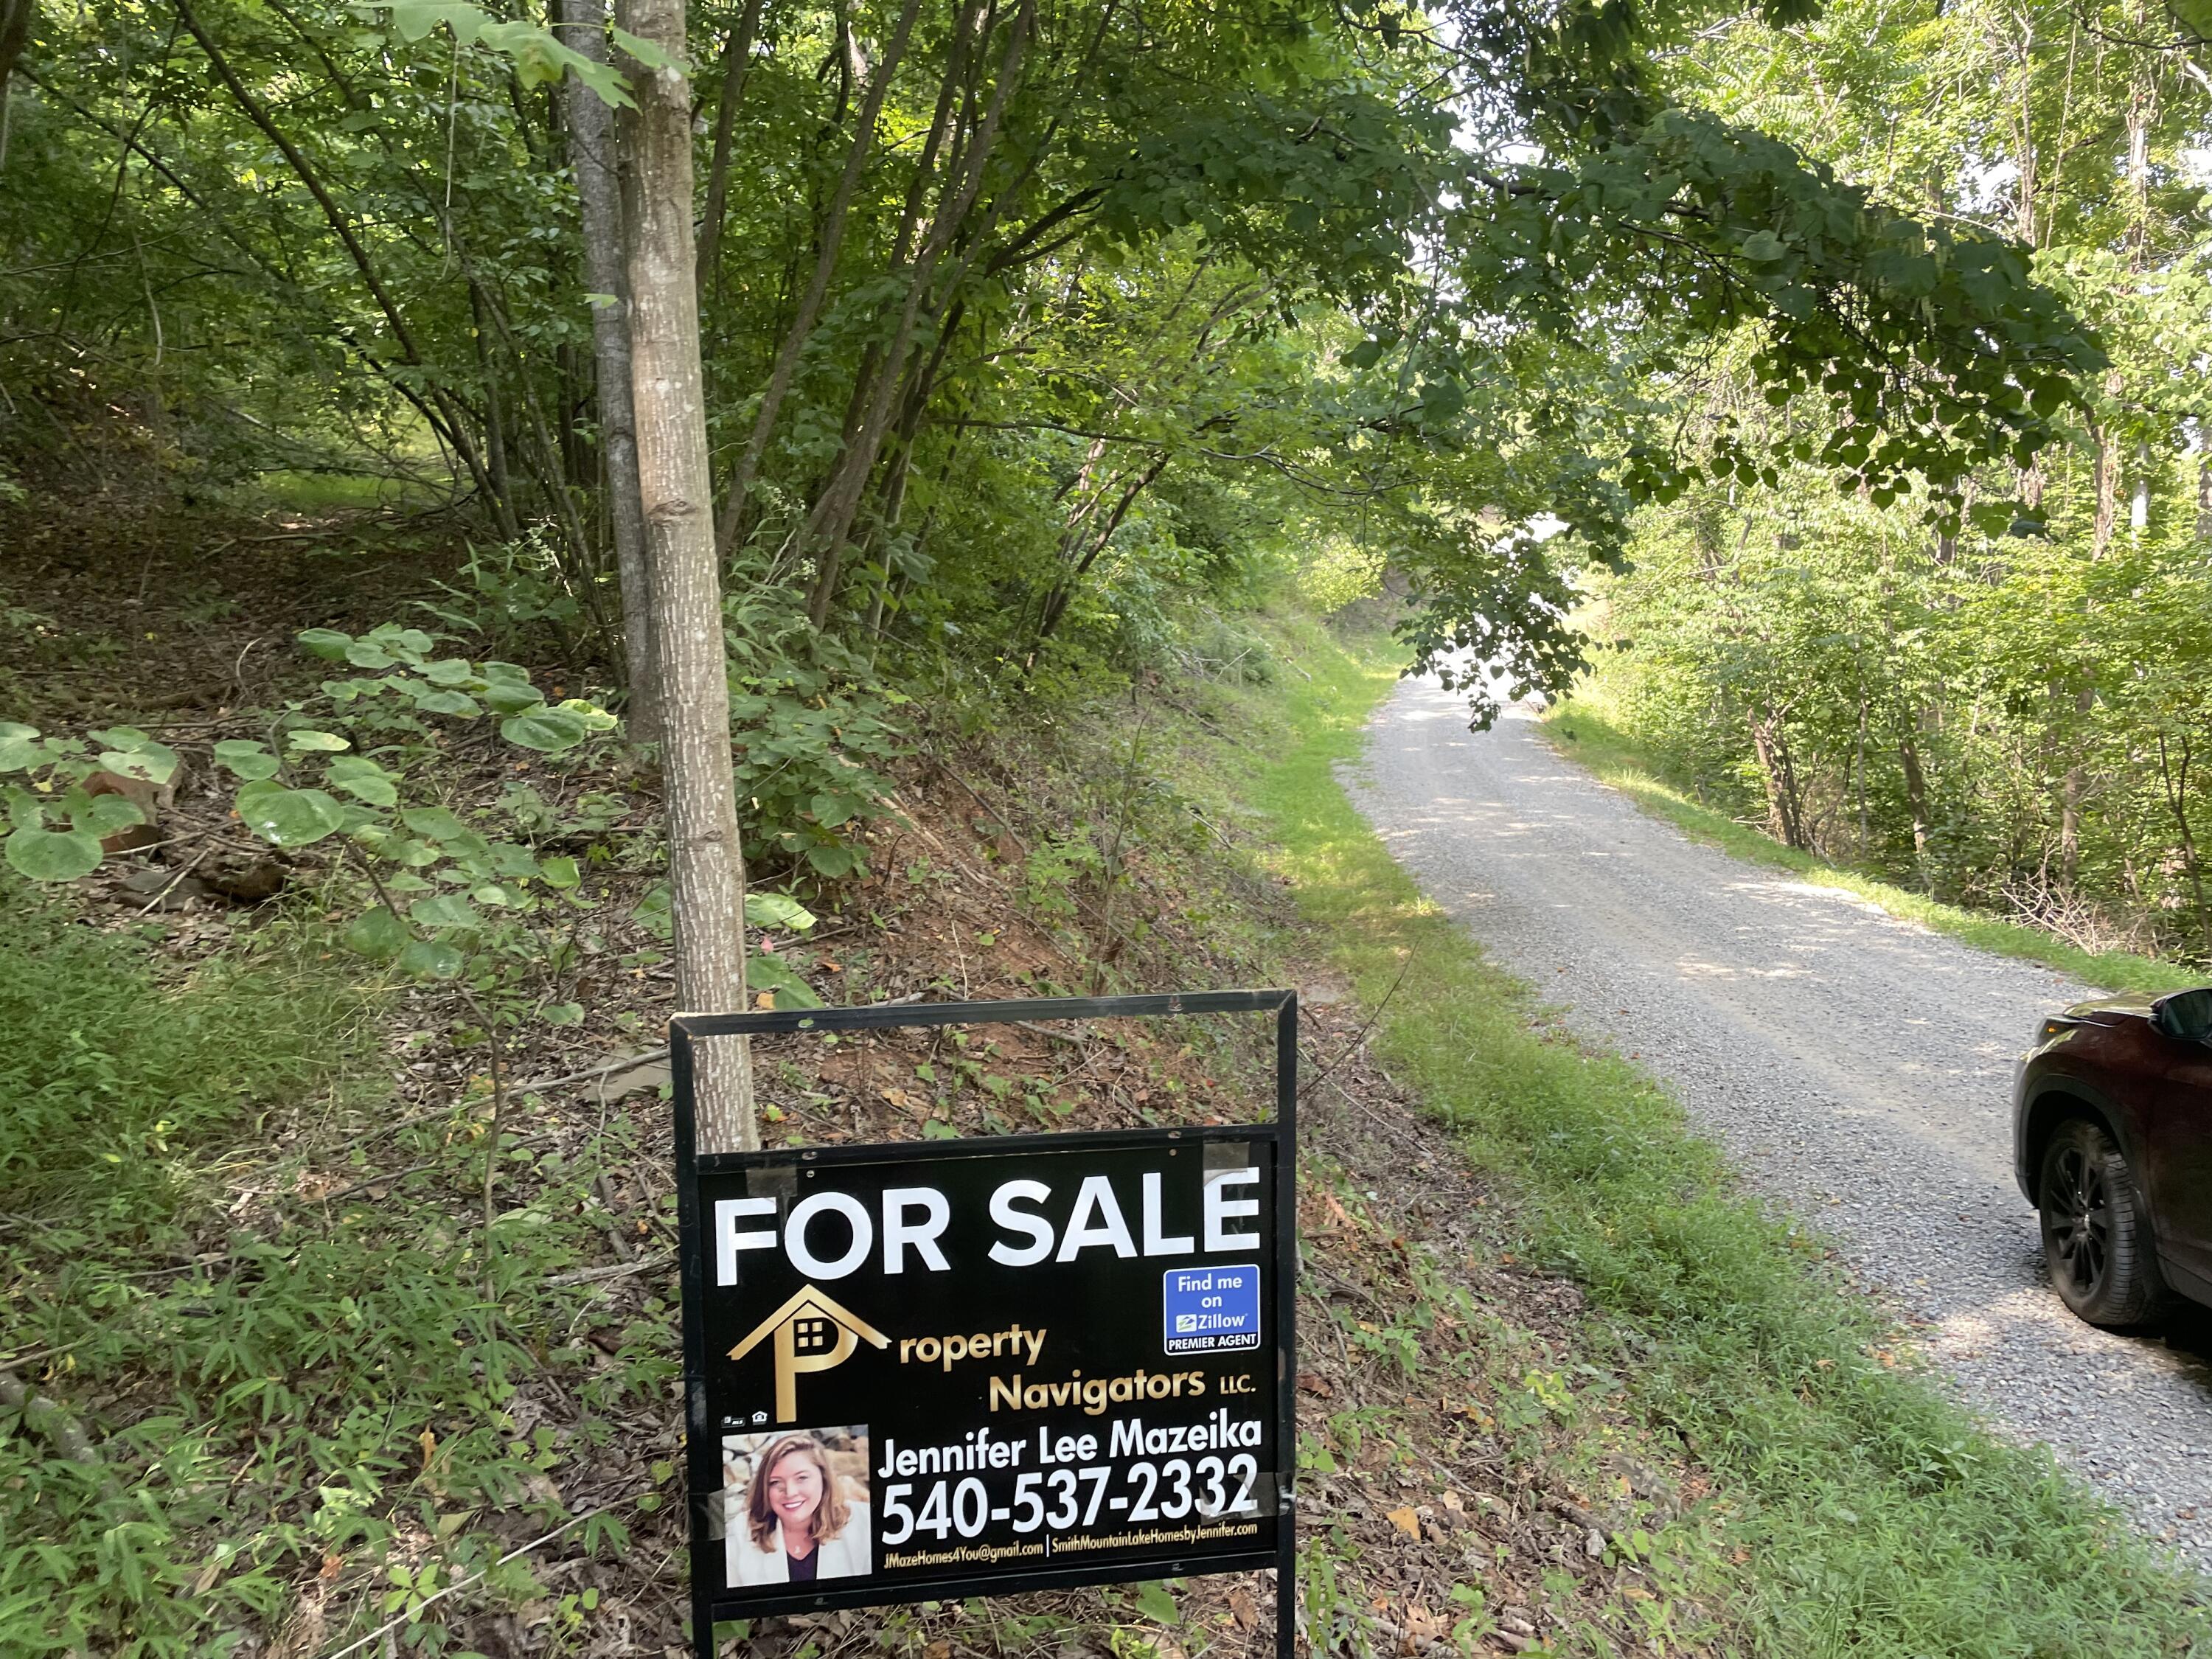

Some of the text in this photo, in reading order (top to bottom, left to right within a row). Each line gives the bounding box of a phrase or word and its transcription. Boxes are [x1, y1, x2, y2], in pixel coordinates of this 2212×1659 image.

[714, 1167, 1260, 1286] FOR SALE
[1178, 1273, 1243, 1292] Find me
[1201, 1295, 1222, 1308] on
[1197, 1313, 1245, 1329] Zillow
[1169, 1333, 1256, 1351] PREMIER AGENT
[990, 1368, 1256, 1416] Navigators LLC.
[877, 1408, 1262, 1478] Jennifer Lee Mazeika
[881, 1453, 1258, 1545] 540-537-2332
[1051, 1520, 1258, 1554] SmithMountainLakeHomesbyJennifer.com
